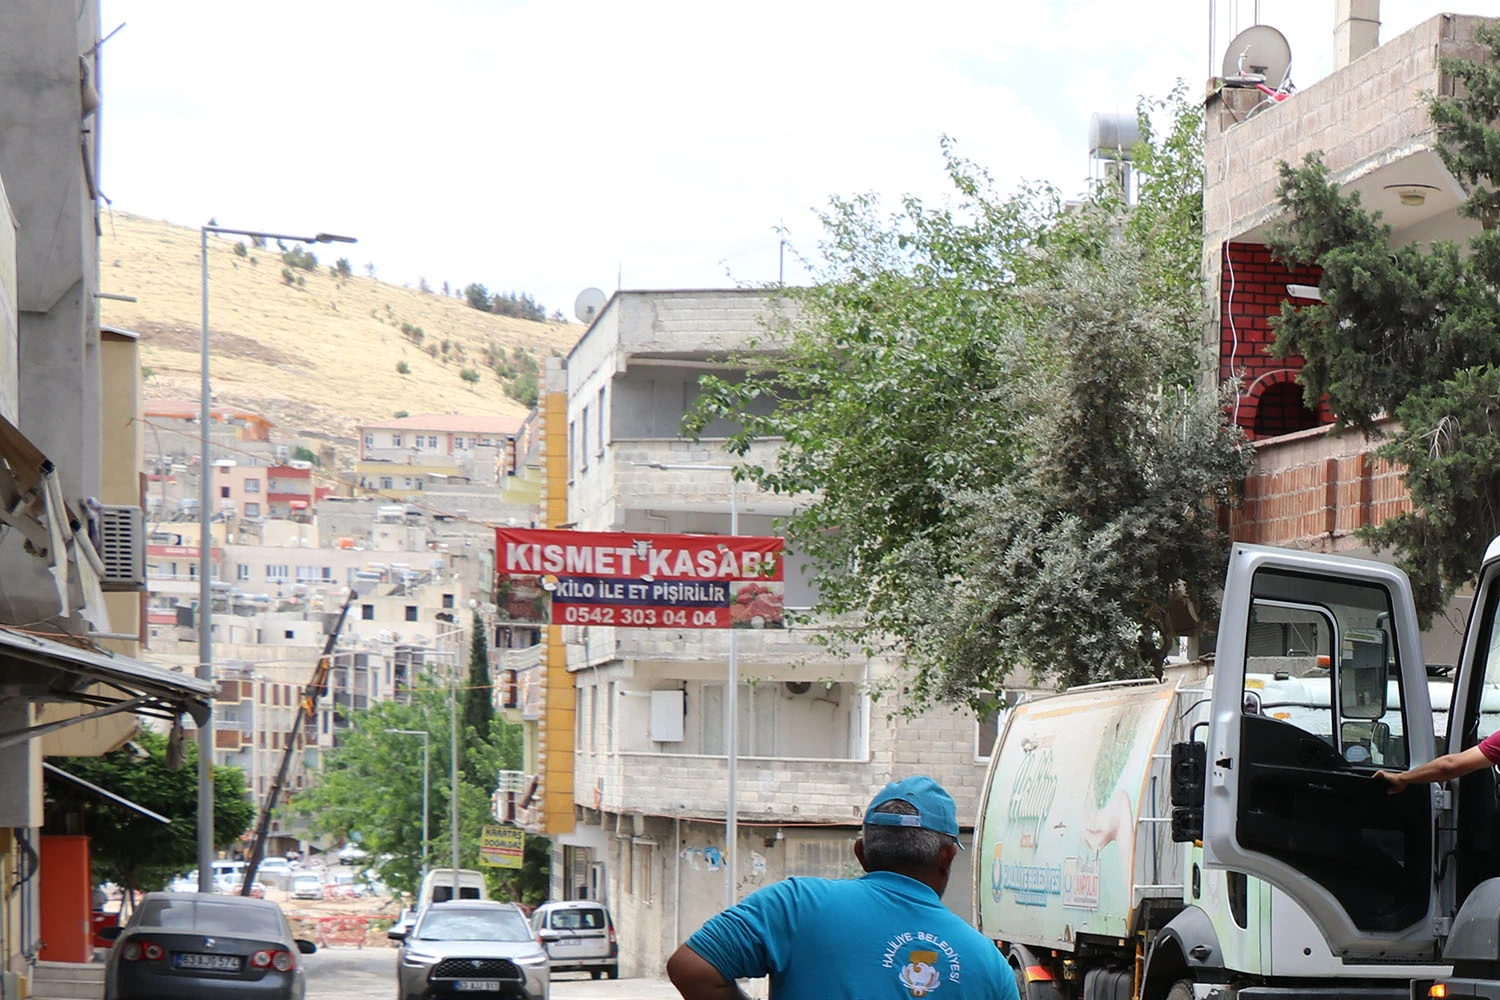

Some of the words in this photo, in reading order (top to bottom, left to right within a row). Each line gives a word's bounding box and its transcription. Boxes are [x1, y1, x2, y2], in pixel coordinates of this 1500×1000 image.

[506, 542, 637, 575] KISMET
[556, 579, 595, 598] KİLO
[599, 581, 625, 599] İLE
[628, 585, 649, 600] ET
[653, 582, 725, 604] PİŞİRİLİR
[565, 606, 614, 624] 0542
[620, 608, 657, 625] 303
[662, 609, 687, 625] 04
[692, 610, 717, 626] 04
[882, 932, 913, 968] HALİLİYE
[918, 931, 960, 984] BELEDİYESİ
